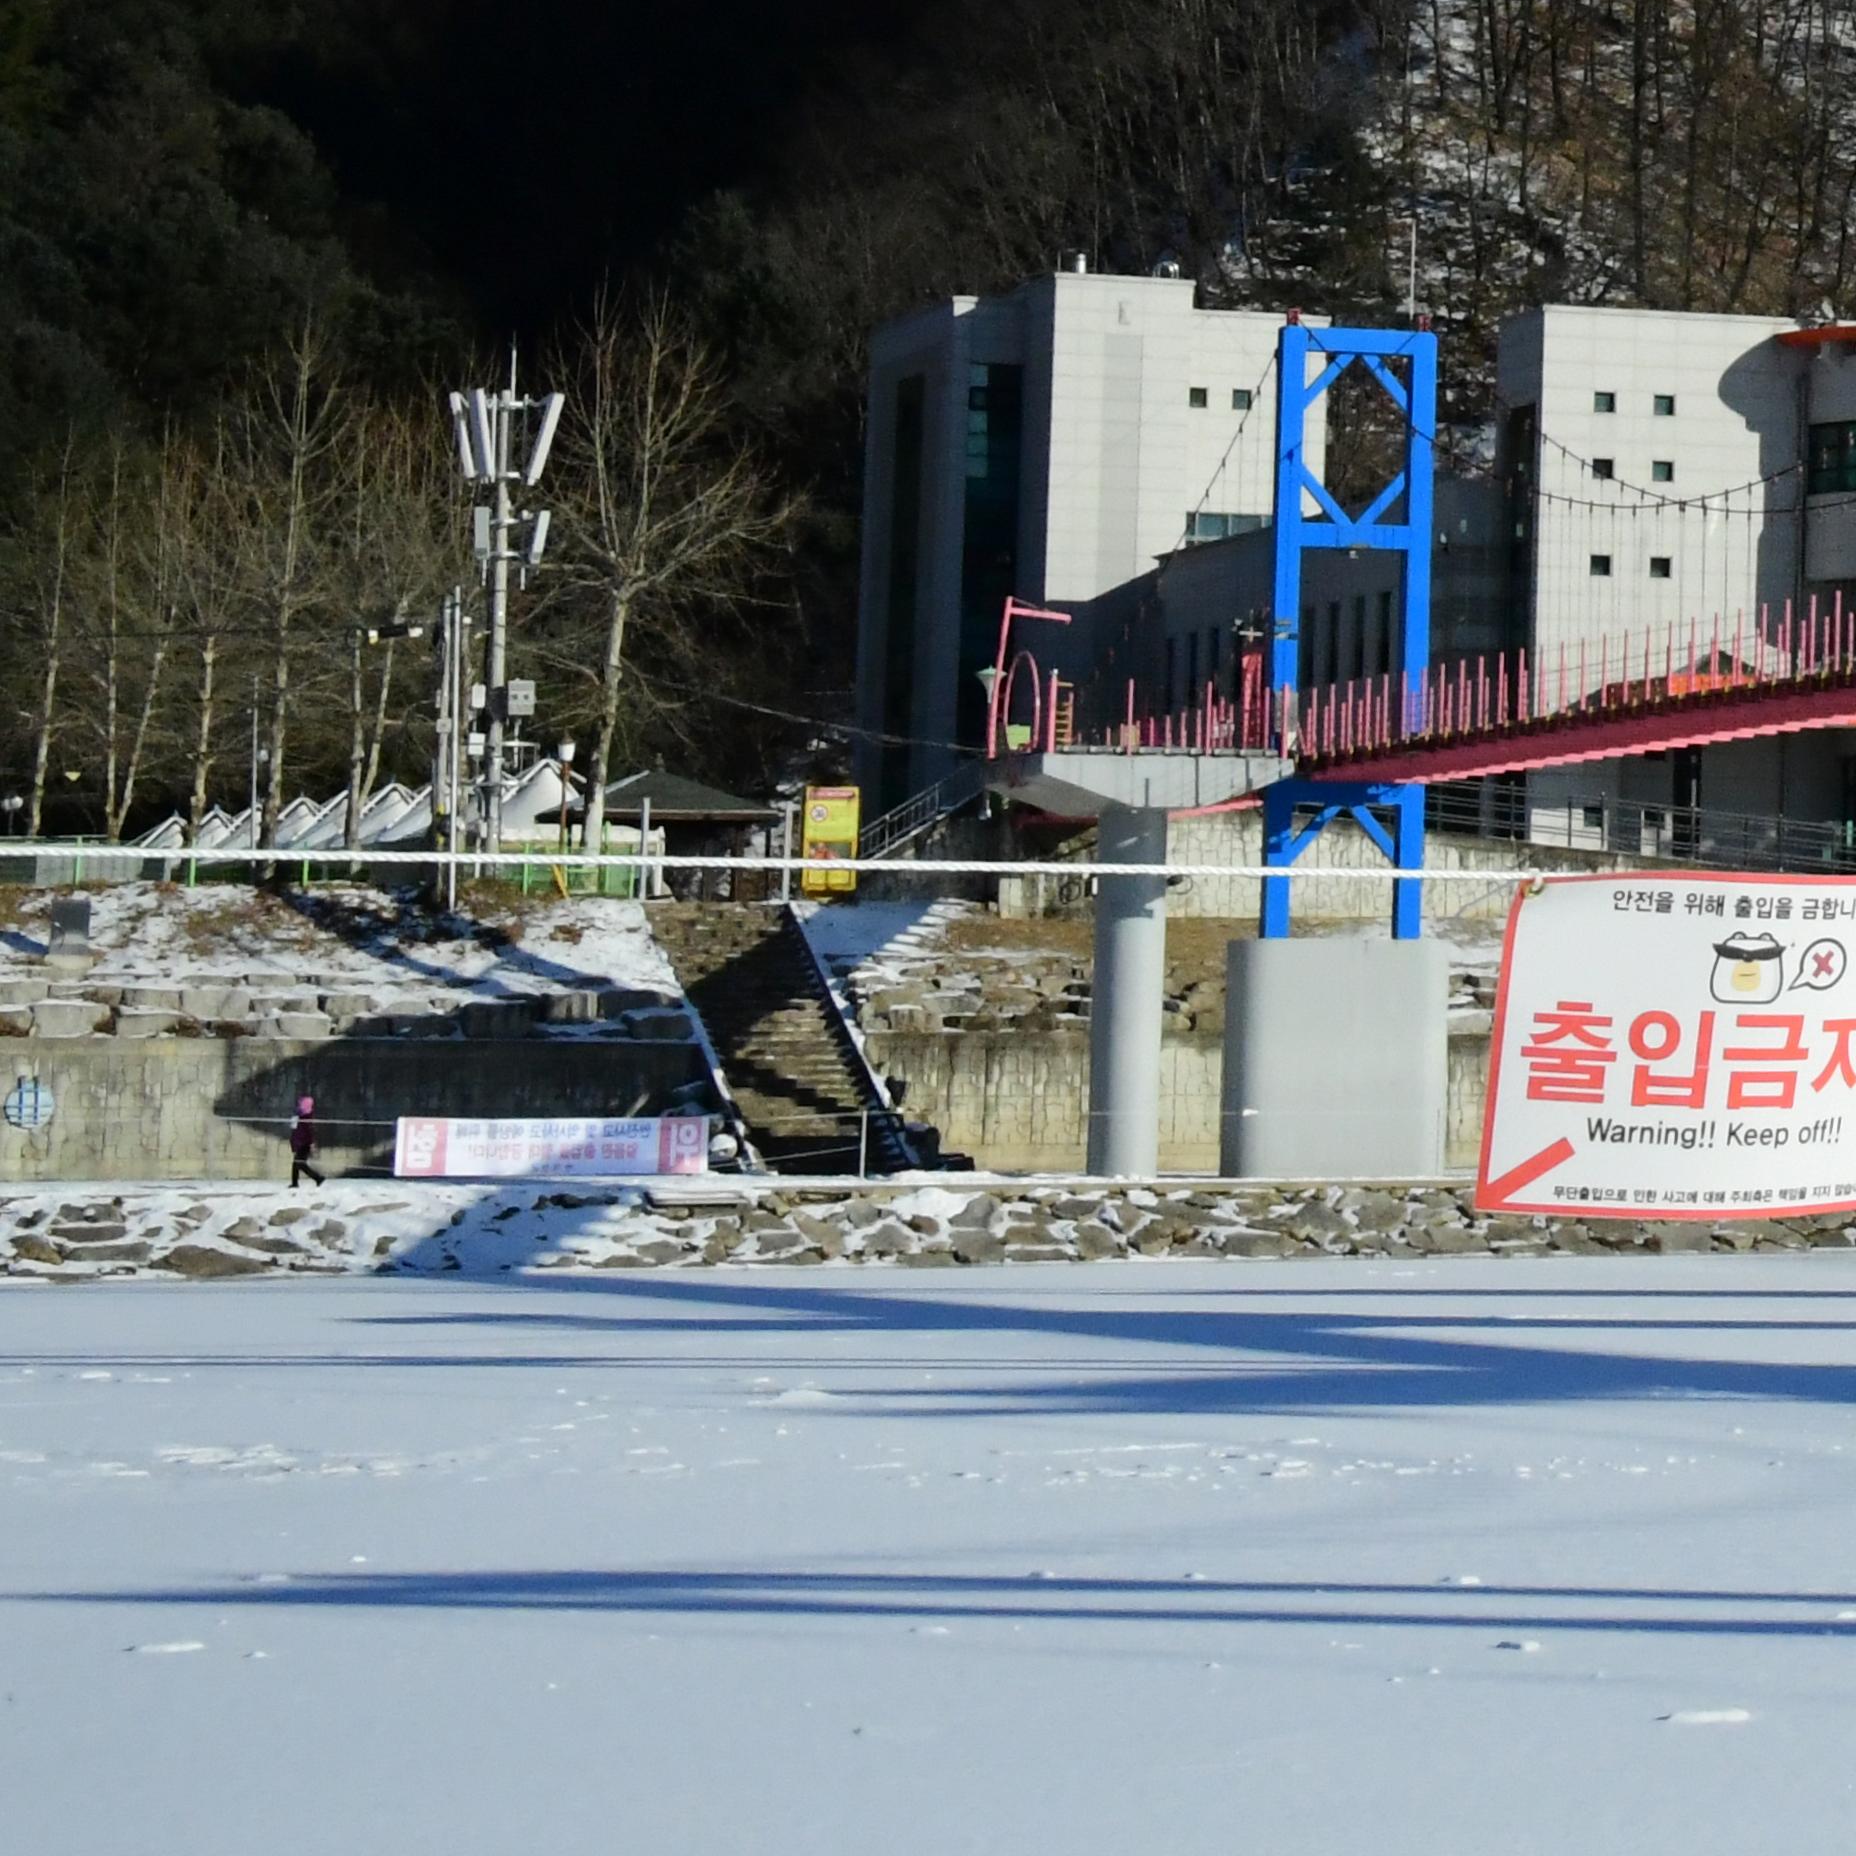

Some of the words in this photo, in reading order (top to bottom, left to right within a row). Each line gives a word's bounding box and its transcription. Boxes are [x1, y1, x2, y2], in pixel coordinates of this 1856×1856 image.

[1613, 890, 1675, 913] 안전을
[1684, 893, 1725, 917] 위해
[1734, 896, 1794, 919] 출입을
[1586, 1117, 1715, 1149] Warning!!
[1726, 1122, 1789, 1149] Keep
[1798, 1117, 1842, 1145] off!!
[1553, 1186, 1627, 1201] 무단출입으로
[1633, 1189, 1657, 1203] 인한
[1662, 1190, 1698, 1204] 사고에
[1703, 1191, 1726, 1204] 대해
[1813, 1185, 1831, 1197] 지지
